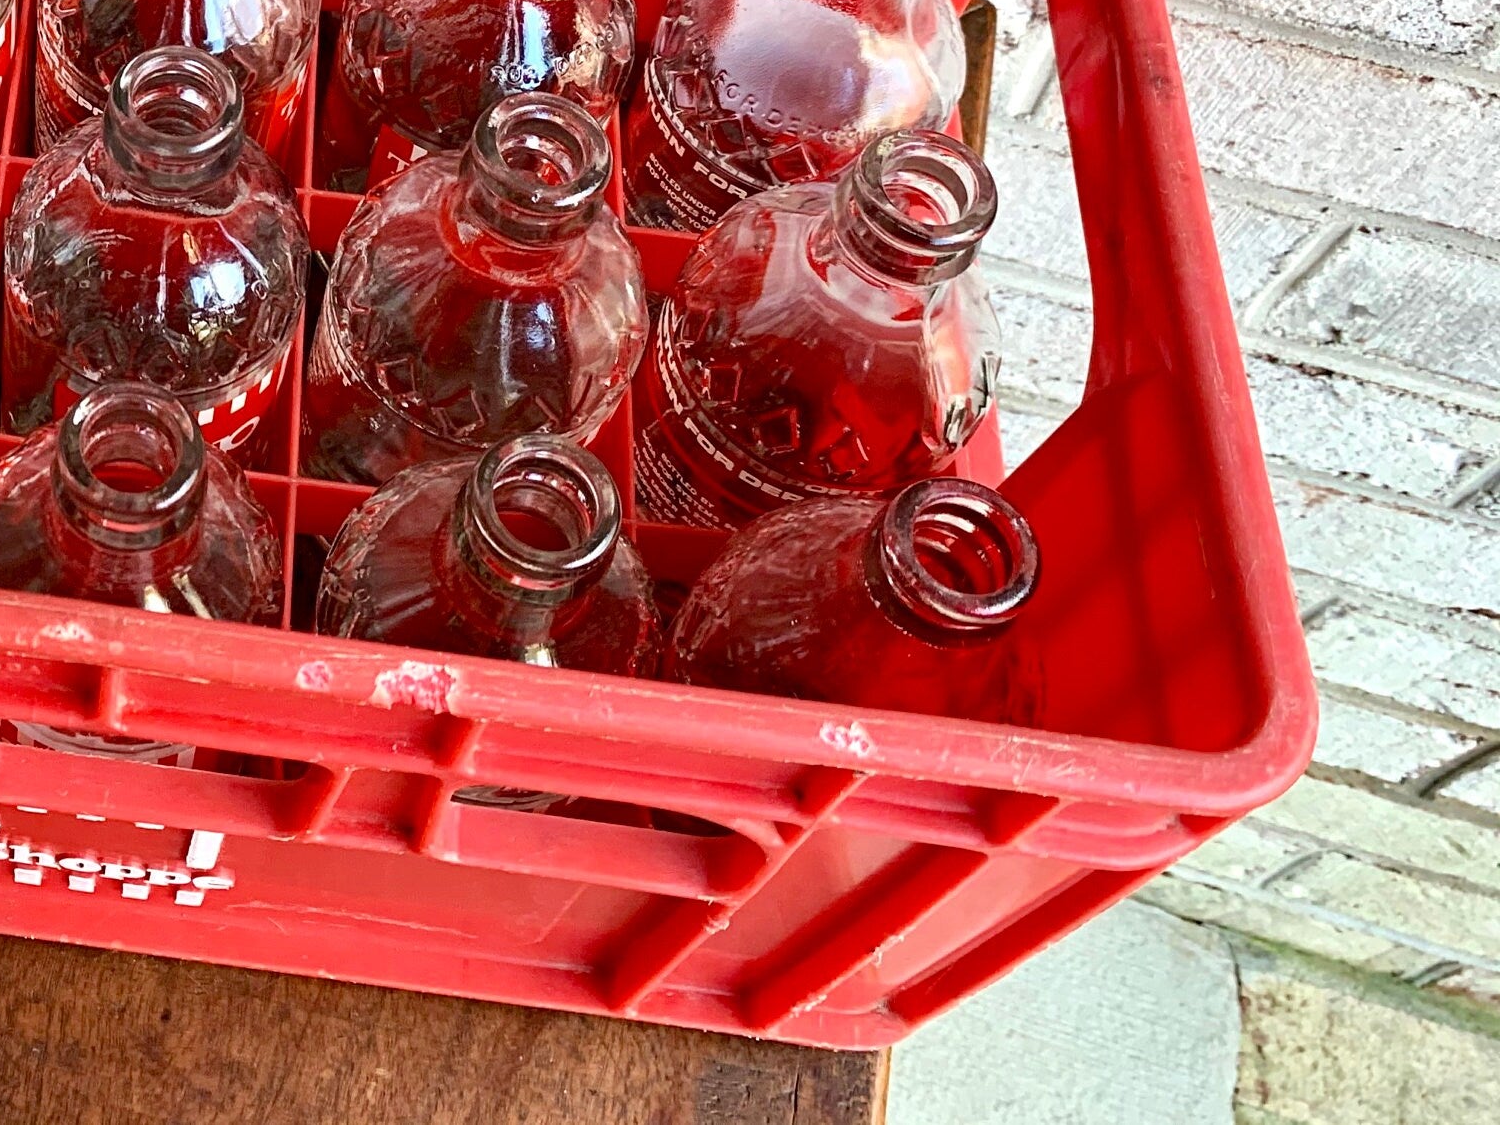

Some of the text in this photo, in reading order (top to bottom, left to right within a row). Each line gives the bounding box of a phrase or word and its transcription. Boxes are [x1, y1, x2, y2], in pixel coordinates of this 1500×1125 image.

[645, 161, 660, 180] POP
[660, 181, 700, 217] SHOPPES
[650, 153, 681, 192] BOTTLED
[683, 192, 717, 217] UNDER
[693, 161, 748, 200] FOR
[666, 199, 709, 232] NEW YOR
[684, 417, 735, 472] FOR
[738, 470, 804, 502] DEP
